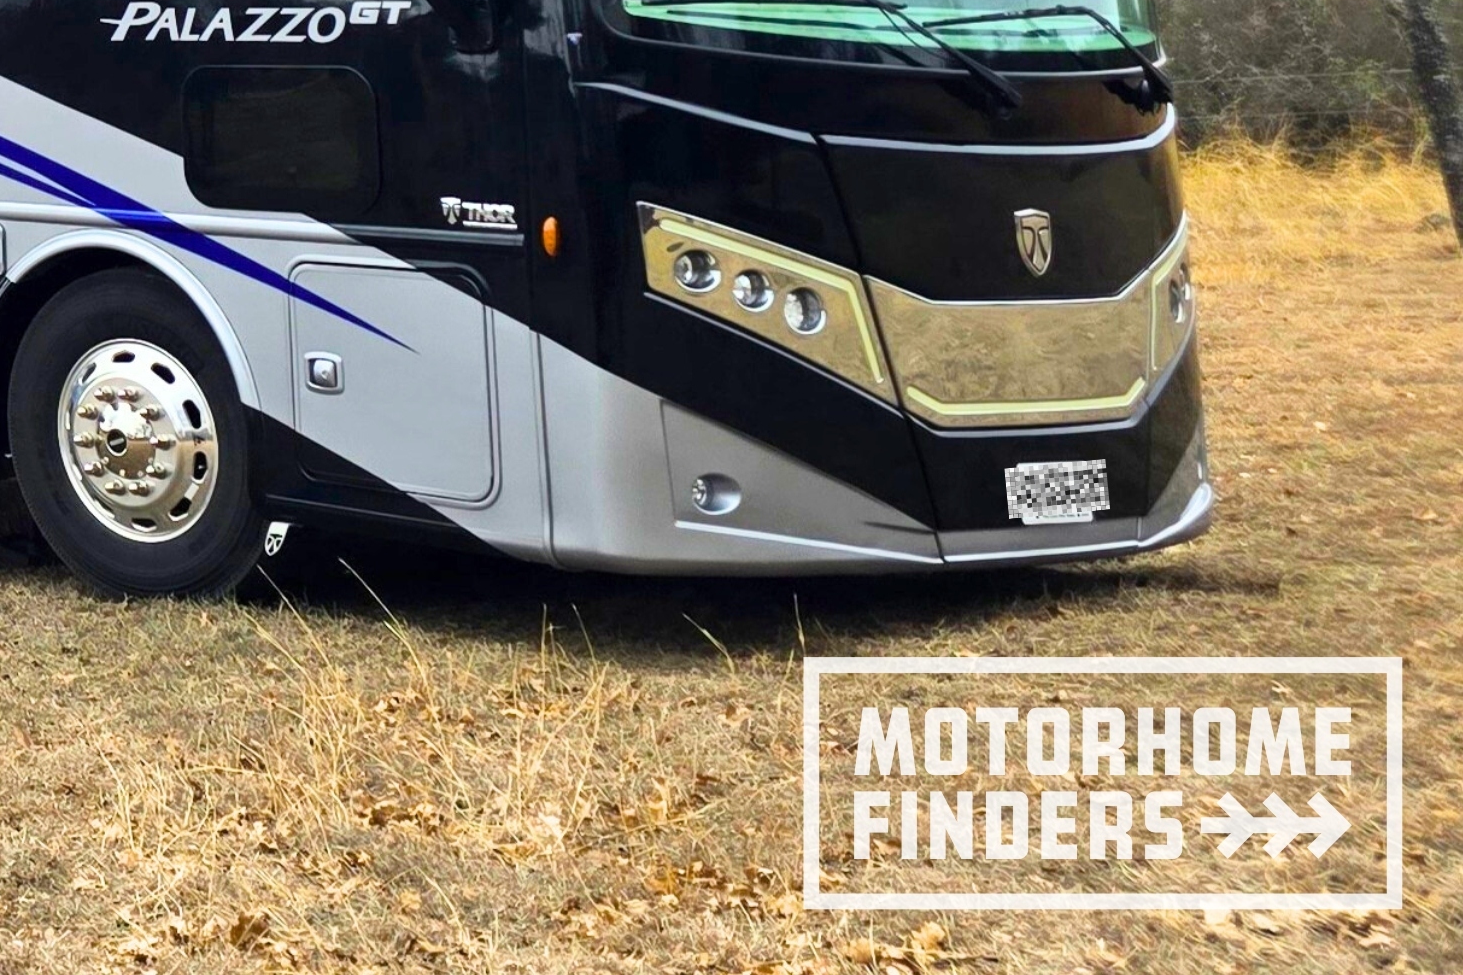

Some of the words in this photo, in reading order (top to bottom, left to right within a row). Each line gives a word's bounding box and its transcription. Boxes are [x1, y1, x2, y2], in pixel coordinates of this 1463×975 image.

[100, 1, 346, 44] PALAZZO
[349, 0, 412, 24] GT
[462, 201, 516, 224] THOR
